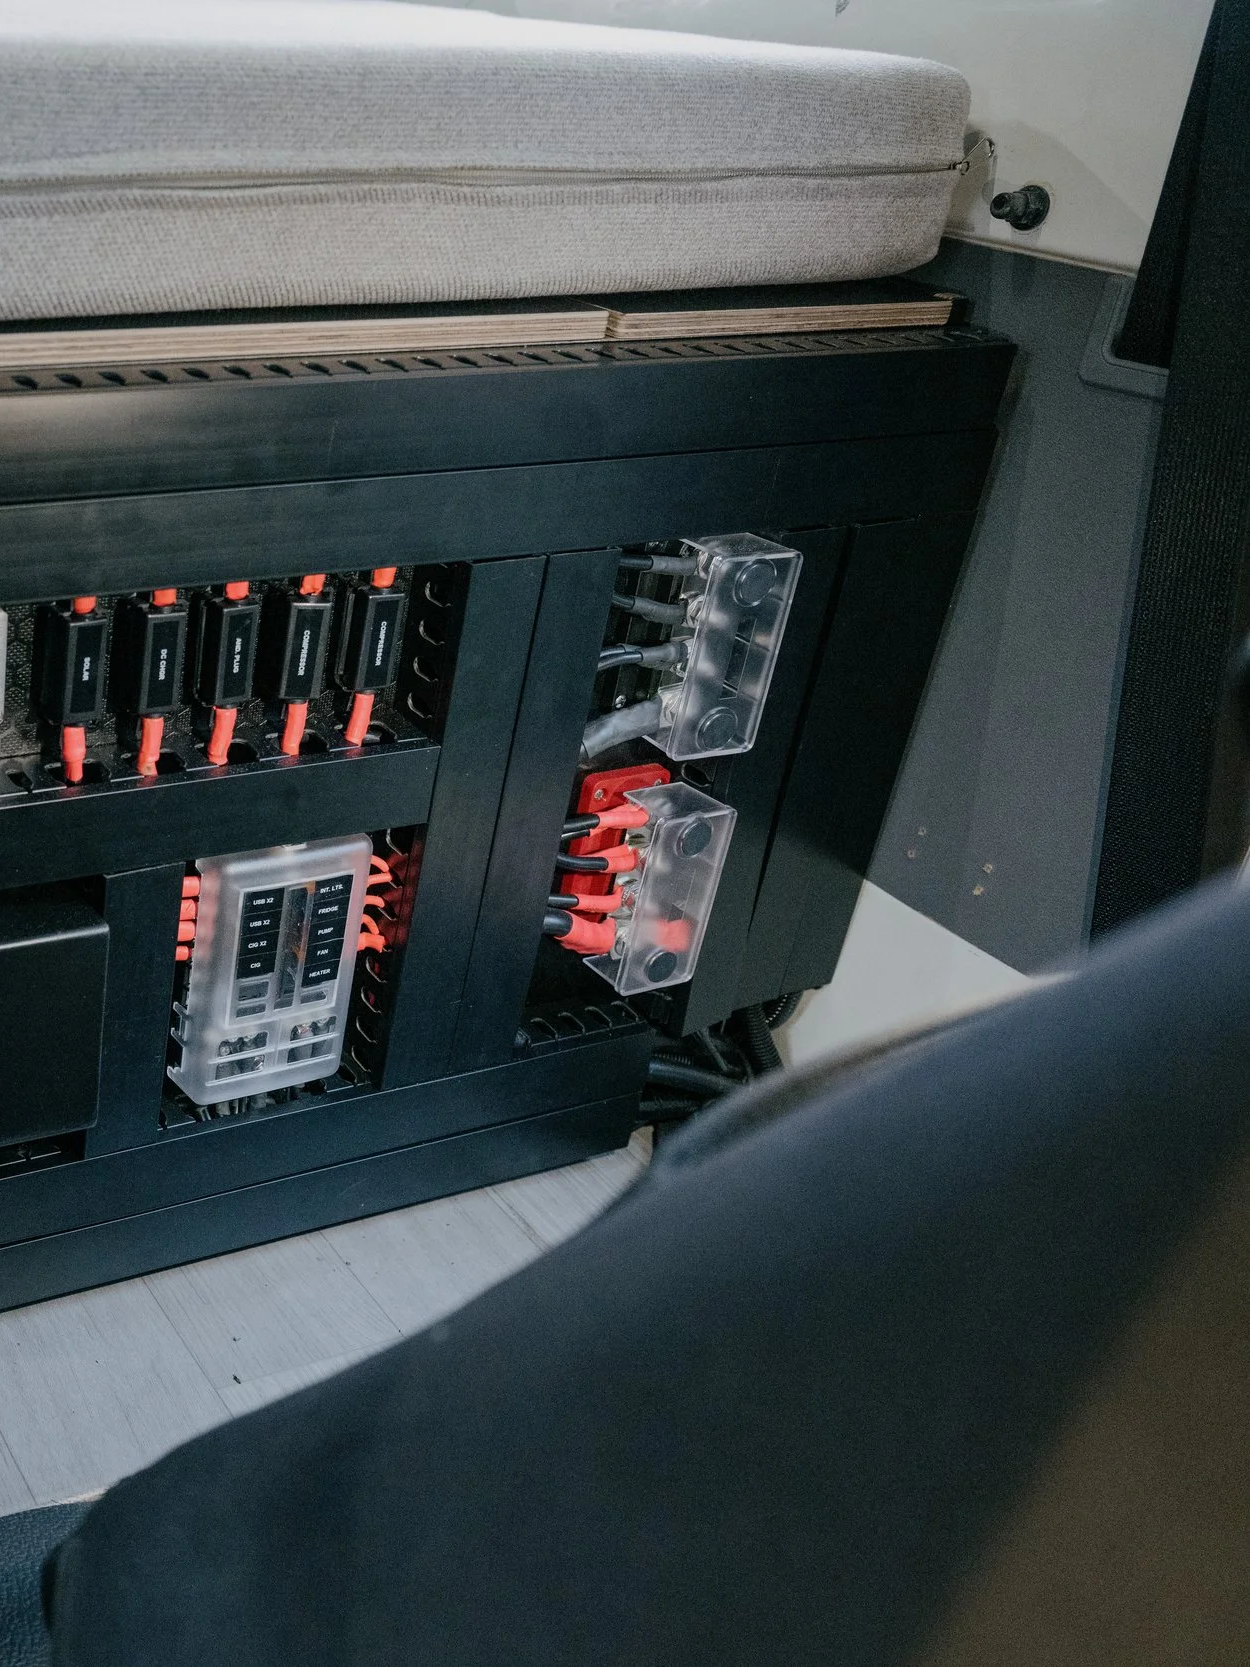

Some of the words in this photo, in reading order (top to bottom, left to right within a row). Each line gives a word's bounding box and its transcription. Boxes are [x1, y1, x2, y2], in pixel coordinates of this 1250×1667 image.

[375, 621, 387, 666] COMPRESSOR
[161, 649, 167, 659] DC
[298, 630, 310, 676] COMPRESSOR
[82, 657, 90, 681] SOLAR
[318, 906, 339, 914] FRIDGE
[318, 927, 334, 935] PUMP
[309, 969, 330, 978] HEATER
